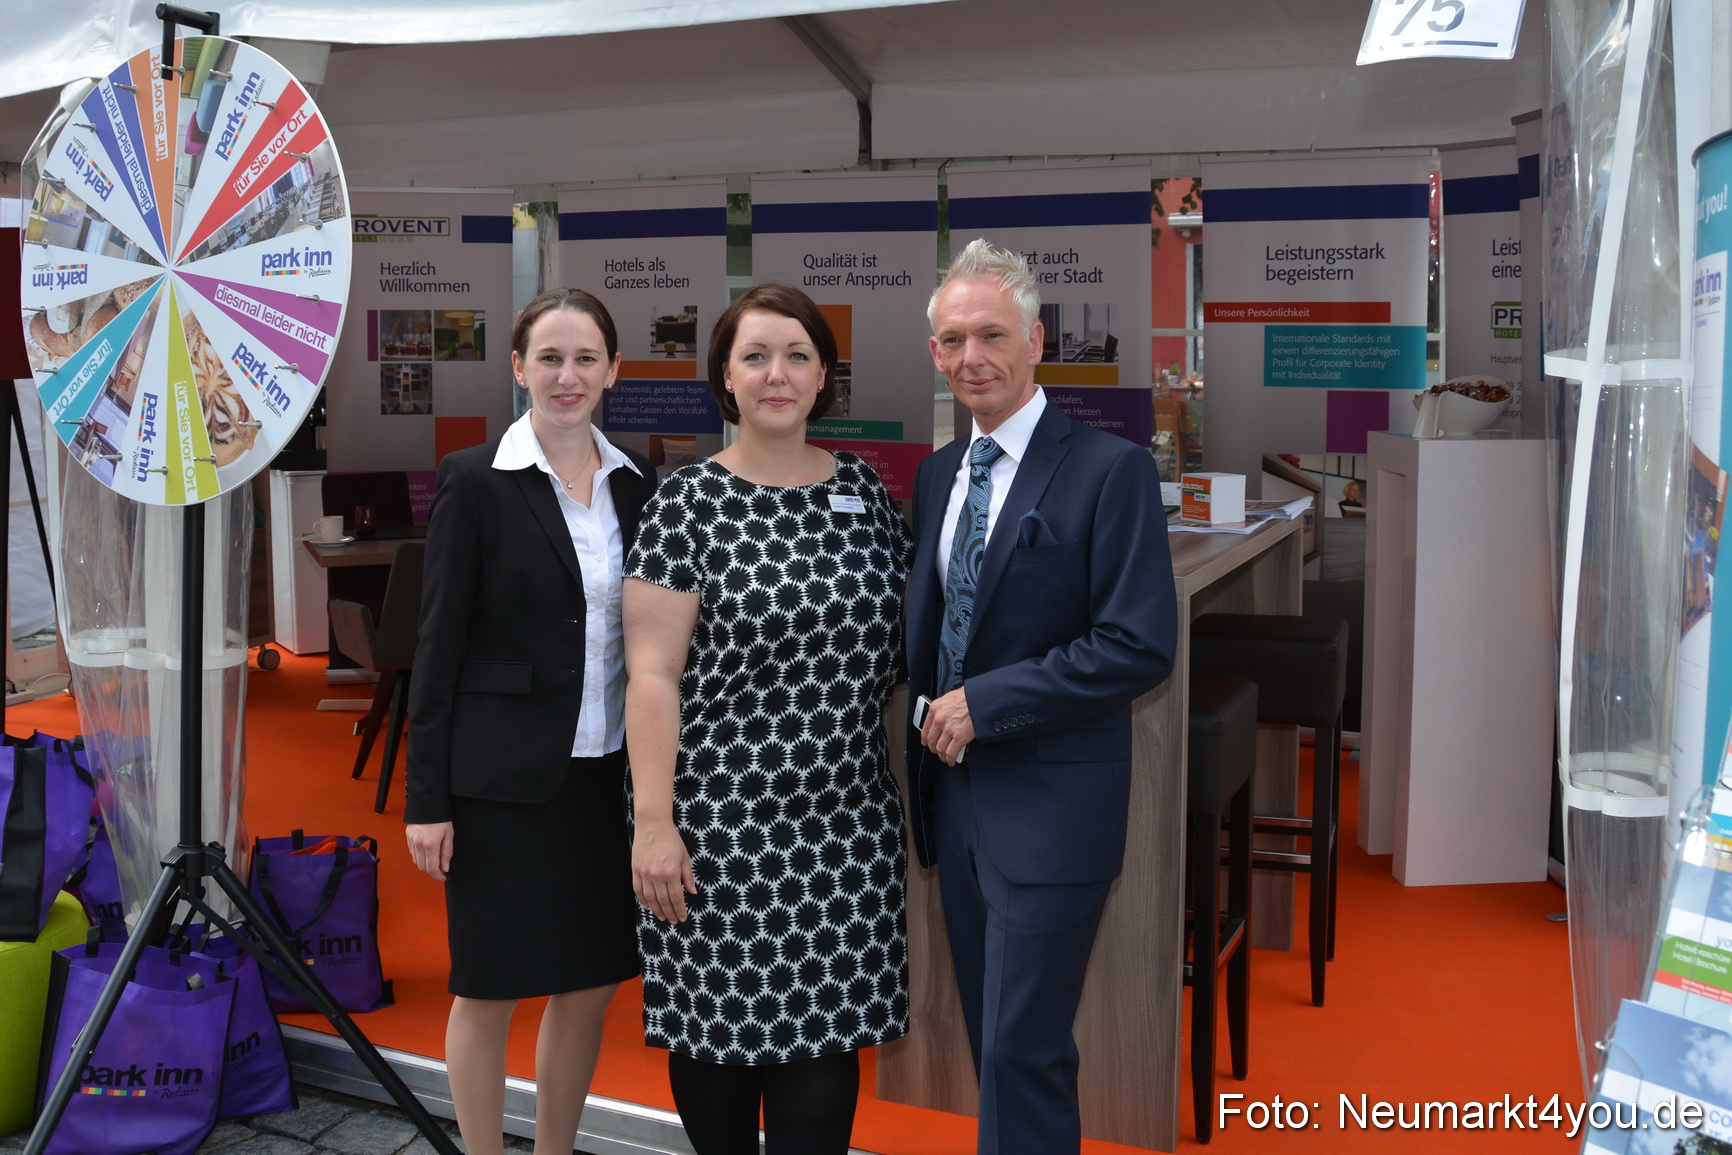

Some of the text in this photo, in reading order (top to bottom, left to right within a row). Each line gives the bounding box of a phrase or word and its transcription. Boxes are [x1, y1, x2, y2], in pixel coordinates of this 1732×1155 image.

[151, 54, 167, 161] für Sie vor Ort
[215, 71, 261, 161] park inn
[102, 84, 152, 211] diesmal leider nicht
[234, 108, 308, 194] für Sie vor Ort
[65, 142, 115, 202] park inn
[1705, 184, 1728, 224] you!
[353, 219, 446, 234] ROVENT
[1266, 242, 1386, 265] Leistungsstark
[1492, 237, 1521, 256] Leist
[261, 246, 332, 276] park inn
[803, 252, 878, 272] Qualität ist
[1042, 248, 1079, 264] auch
[380, 261, 436, 276] Herzlich
[604, 257, 666, 273] Hotels als
[32, 263, 88, 291] park inn
[604, 274, 690, 290] Ganzes leben
[803, 270, 912, 291] unser Anspruch
[1063, 267, 1104, 284] Stadt
[1265, 264, 1354, 286] begeistern
[1706, 268, 1722, 293] inn
[379, 278, 471, 293] Willkommen
[216, 287, 327, 349] diesmal leider nicht
[1214, 307, 1310, 318] Unsere Persönlichkeit
[1272, 333, 1392, 344] Internationale Standards mit
[1495, 329, 1520, 338] HOTE
[1272, 345, 1400, 358] einem differenzierungsfähigen
[1272, 357, 1386, 370] Profil für Corporate Identity
[53, 341, 113, 416] für Sie vor Ort
[231, 341, 291, 412] park inn
[1272, 370, 1341, 380] mit Individualität
[620, 385, 652, 394] Kreativität,
[653, 385, 685, 395] gelebtem
[686, 386, 706, 394] Team-
[625, 396, 638, 404] und
[640, 405, 662, 414] Gästen
[663, 406, 677, 414] den
[1073, 408, 1101, 416] Herzen
[608, 416, 658, 424] effekt schenken
[1083, 419, 1124, 428] modernen
[137, 392, 159, 483] park inn
[176, 381, 196, 493] für Sie vor Ort
[807, 424, 863, 435] tsmanagement
[886, 484, 903, 492] ation
[319, 933, 362, 955] inn
[1715, 935, 1732, 948] yo
[154, 1063, 203, 1086] inn
[161, 1086, 200, 1100] Radisson
